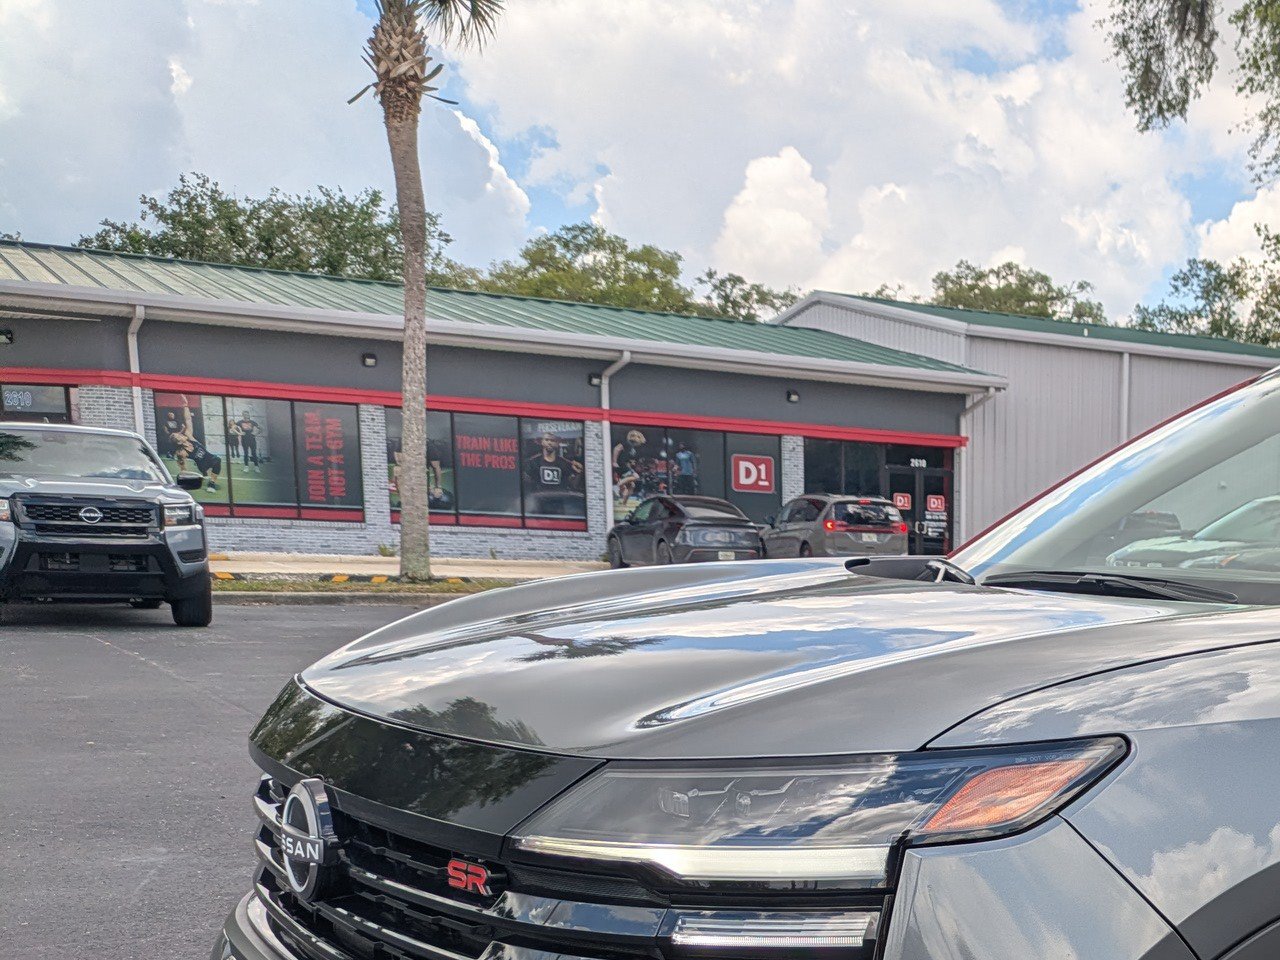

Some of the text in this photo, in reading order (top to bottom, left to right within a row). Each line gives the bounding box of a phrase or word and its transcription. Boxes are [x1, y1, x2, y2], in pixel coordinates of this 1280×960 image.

[456, 434, 518, 453] TRAIN LIKE
[307, 456, 324, 465] A
[326, 418, 346, 496] NOT A GYM
[460, 453, 516, 469] THE PROS
[739, 460, 769, 486] D1
[308, 470, 326, 501] JOIN
[930, 498, 943, 509] D1
[448, 859, 492, 896] SR
